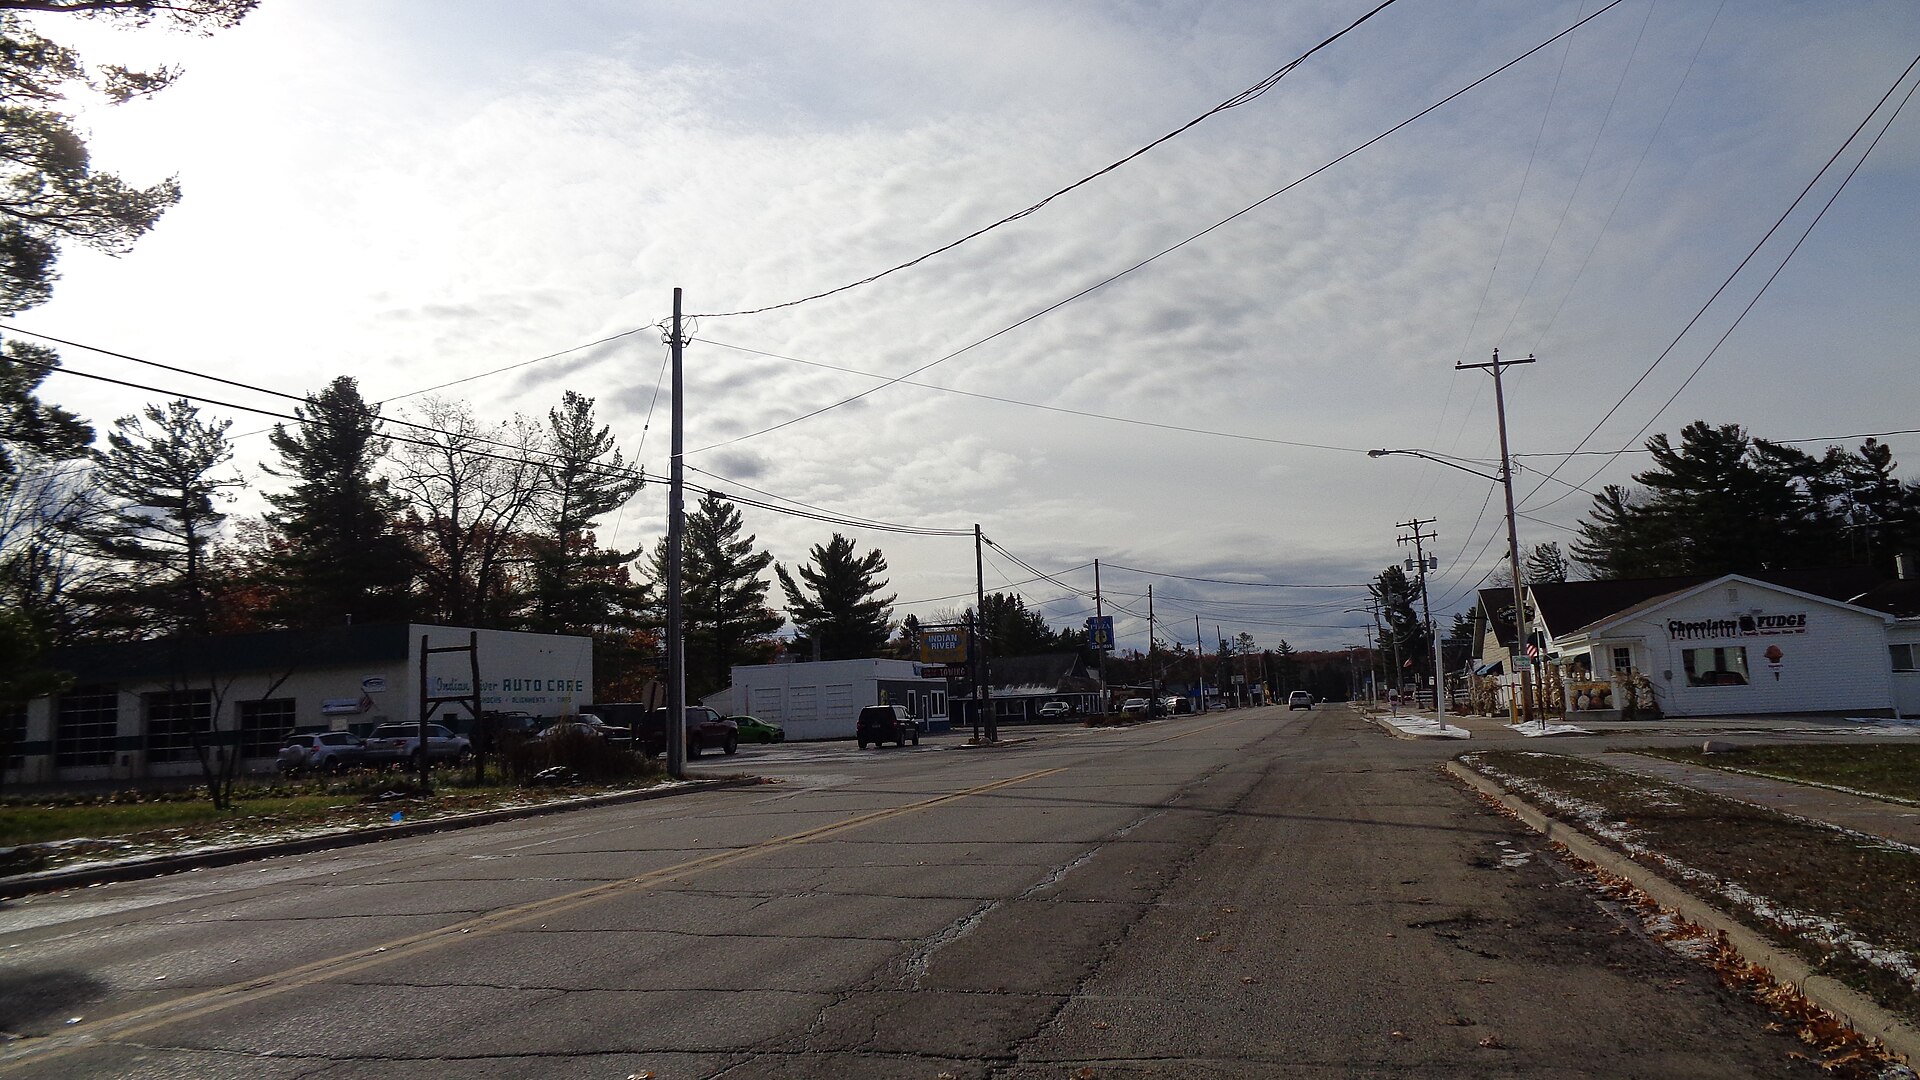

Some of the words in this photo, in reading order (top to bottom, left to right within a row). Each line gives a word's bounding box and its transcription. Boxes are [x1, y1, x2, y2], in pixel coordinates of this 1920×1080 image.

[1668, 618, 1737, 636] Chocolates
[1756, 614, 1806, 628] FUDGE
[928, 634, 958, 642] INDIAN
[931, 642, 956, 650] RIVER
[940, 667, 965, 676] TOWING
[436, 676, 470, 692] Indian
[478, 679, 498, 691] iver
[503, 679, 542, 692] AUTO
[547, 679, 583, 692] CARE
[511, 696, 546, 704] ALIGNMENTS
